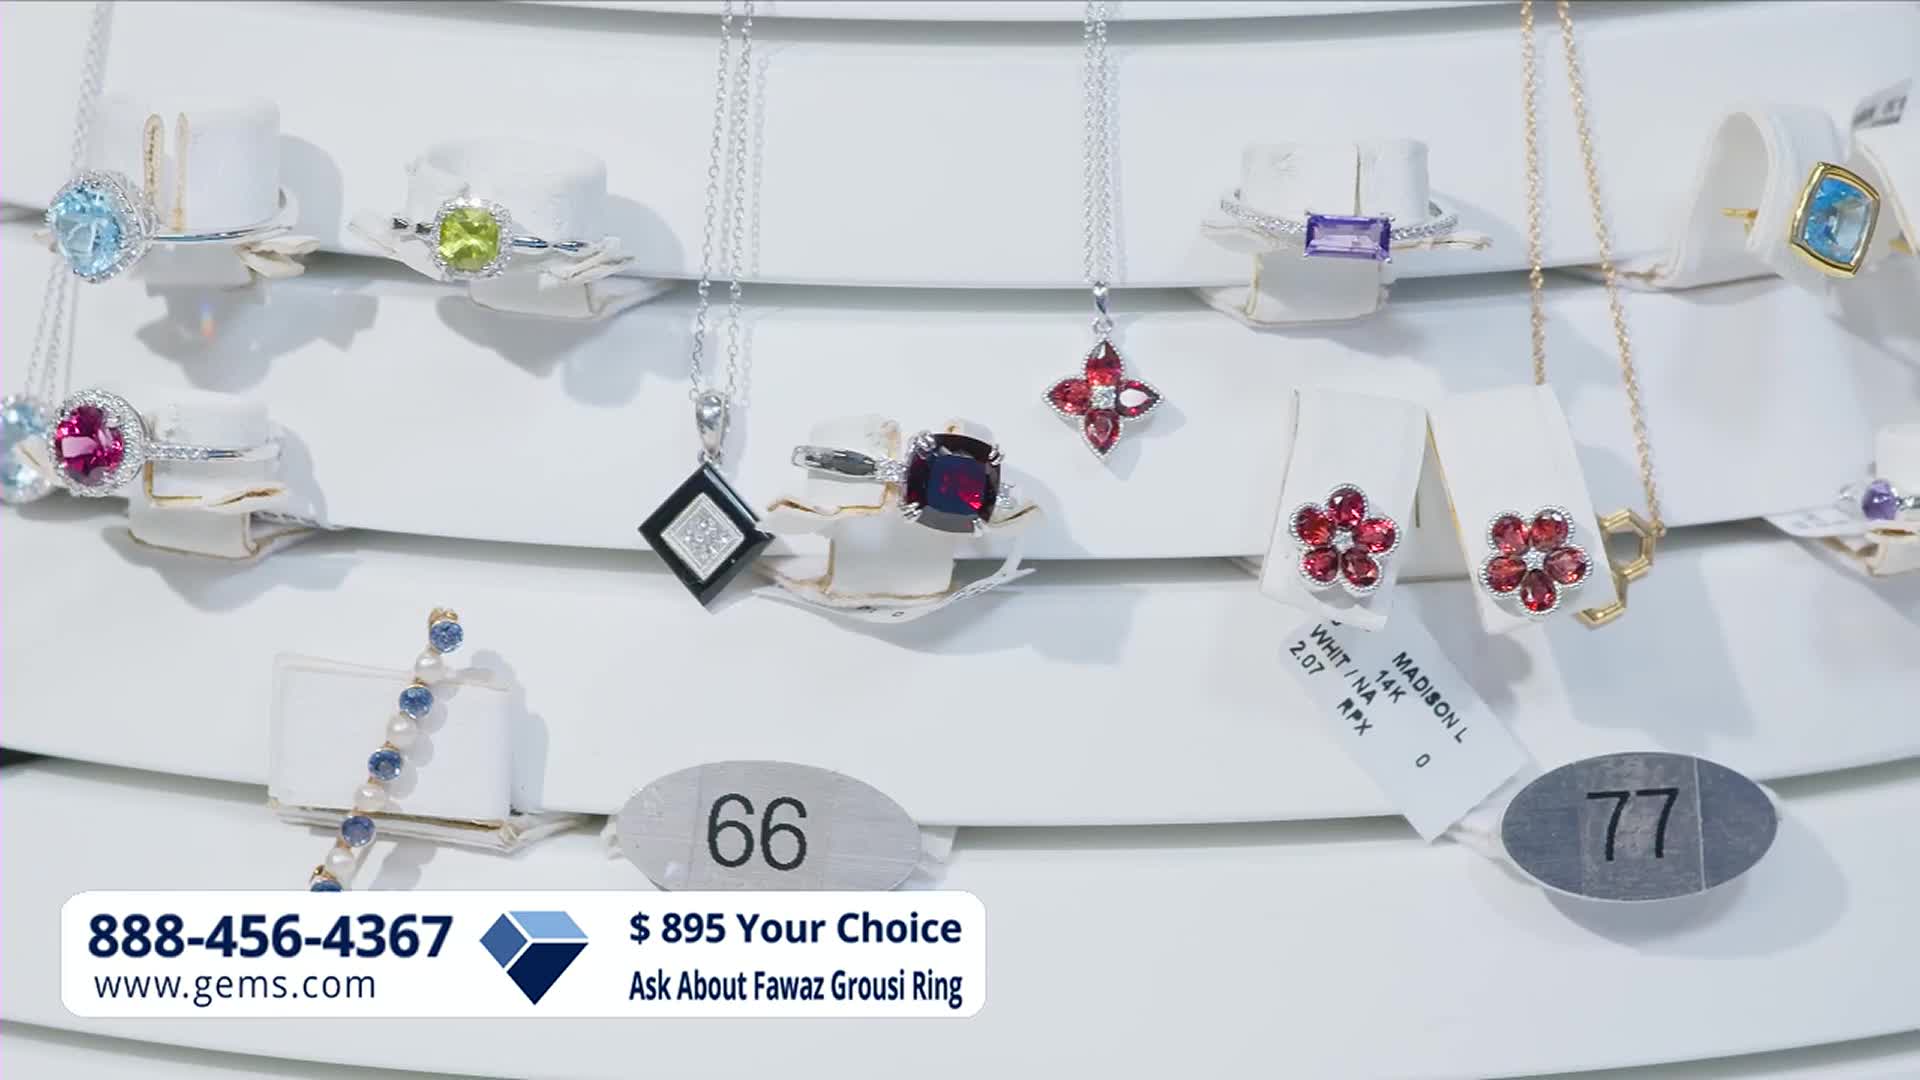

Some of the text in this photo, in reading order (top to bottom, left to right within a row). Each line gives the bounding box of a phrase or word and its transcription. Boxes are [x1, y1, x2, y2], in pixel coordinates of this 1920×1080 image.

[1289, 640, 1373, 736] 2.07 RPX
[1310, 623, 1352, 668] WHIT
[1352, 676, 1377, 705] NA
[1375, 669, 1407, 704] 14K
[1391, 651, 1468, 743] MADISON L
[708, 793, 807, 870] 66
[1586, 787, 1679, 861] 77
